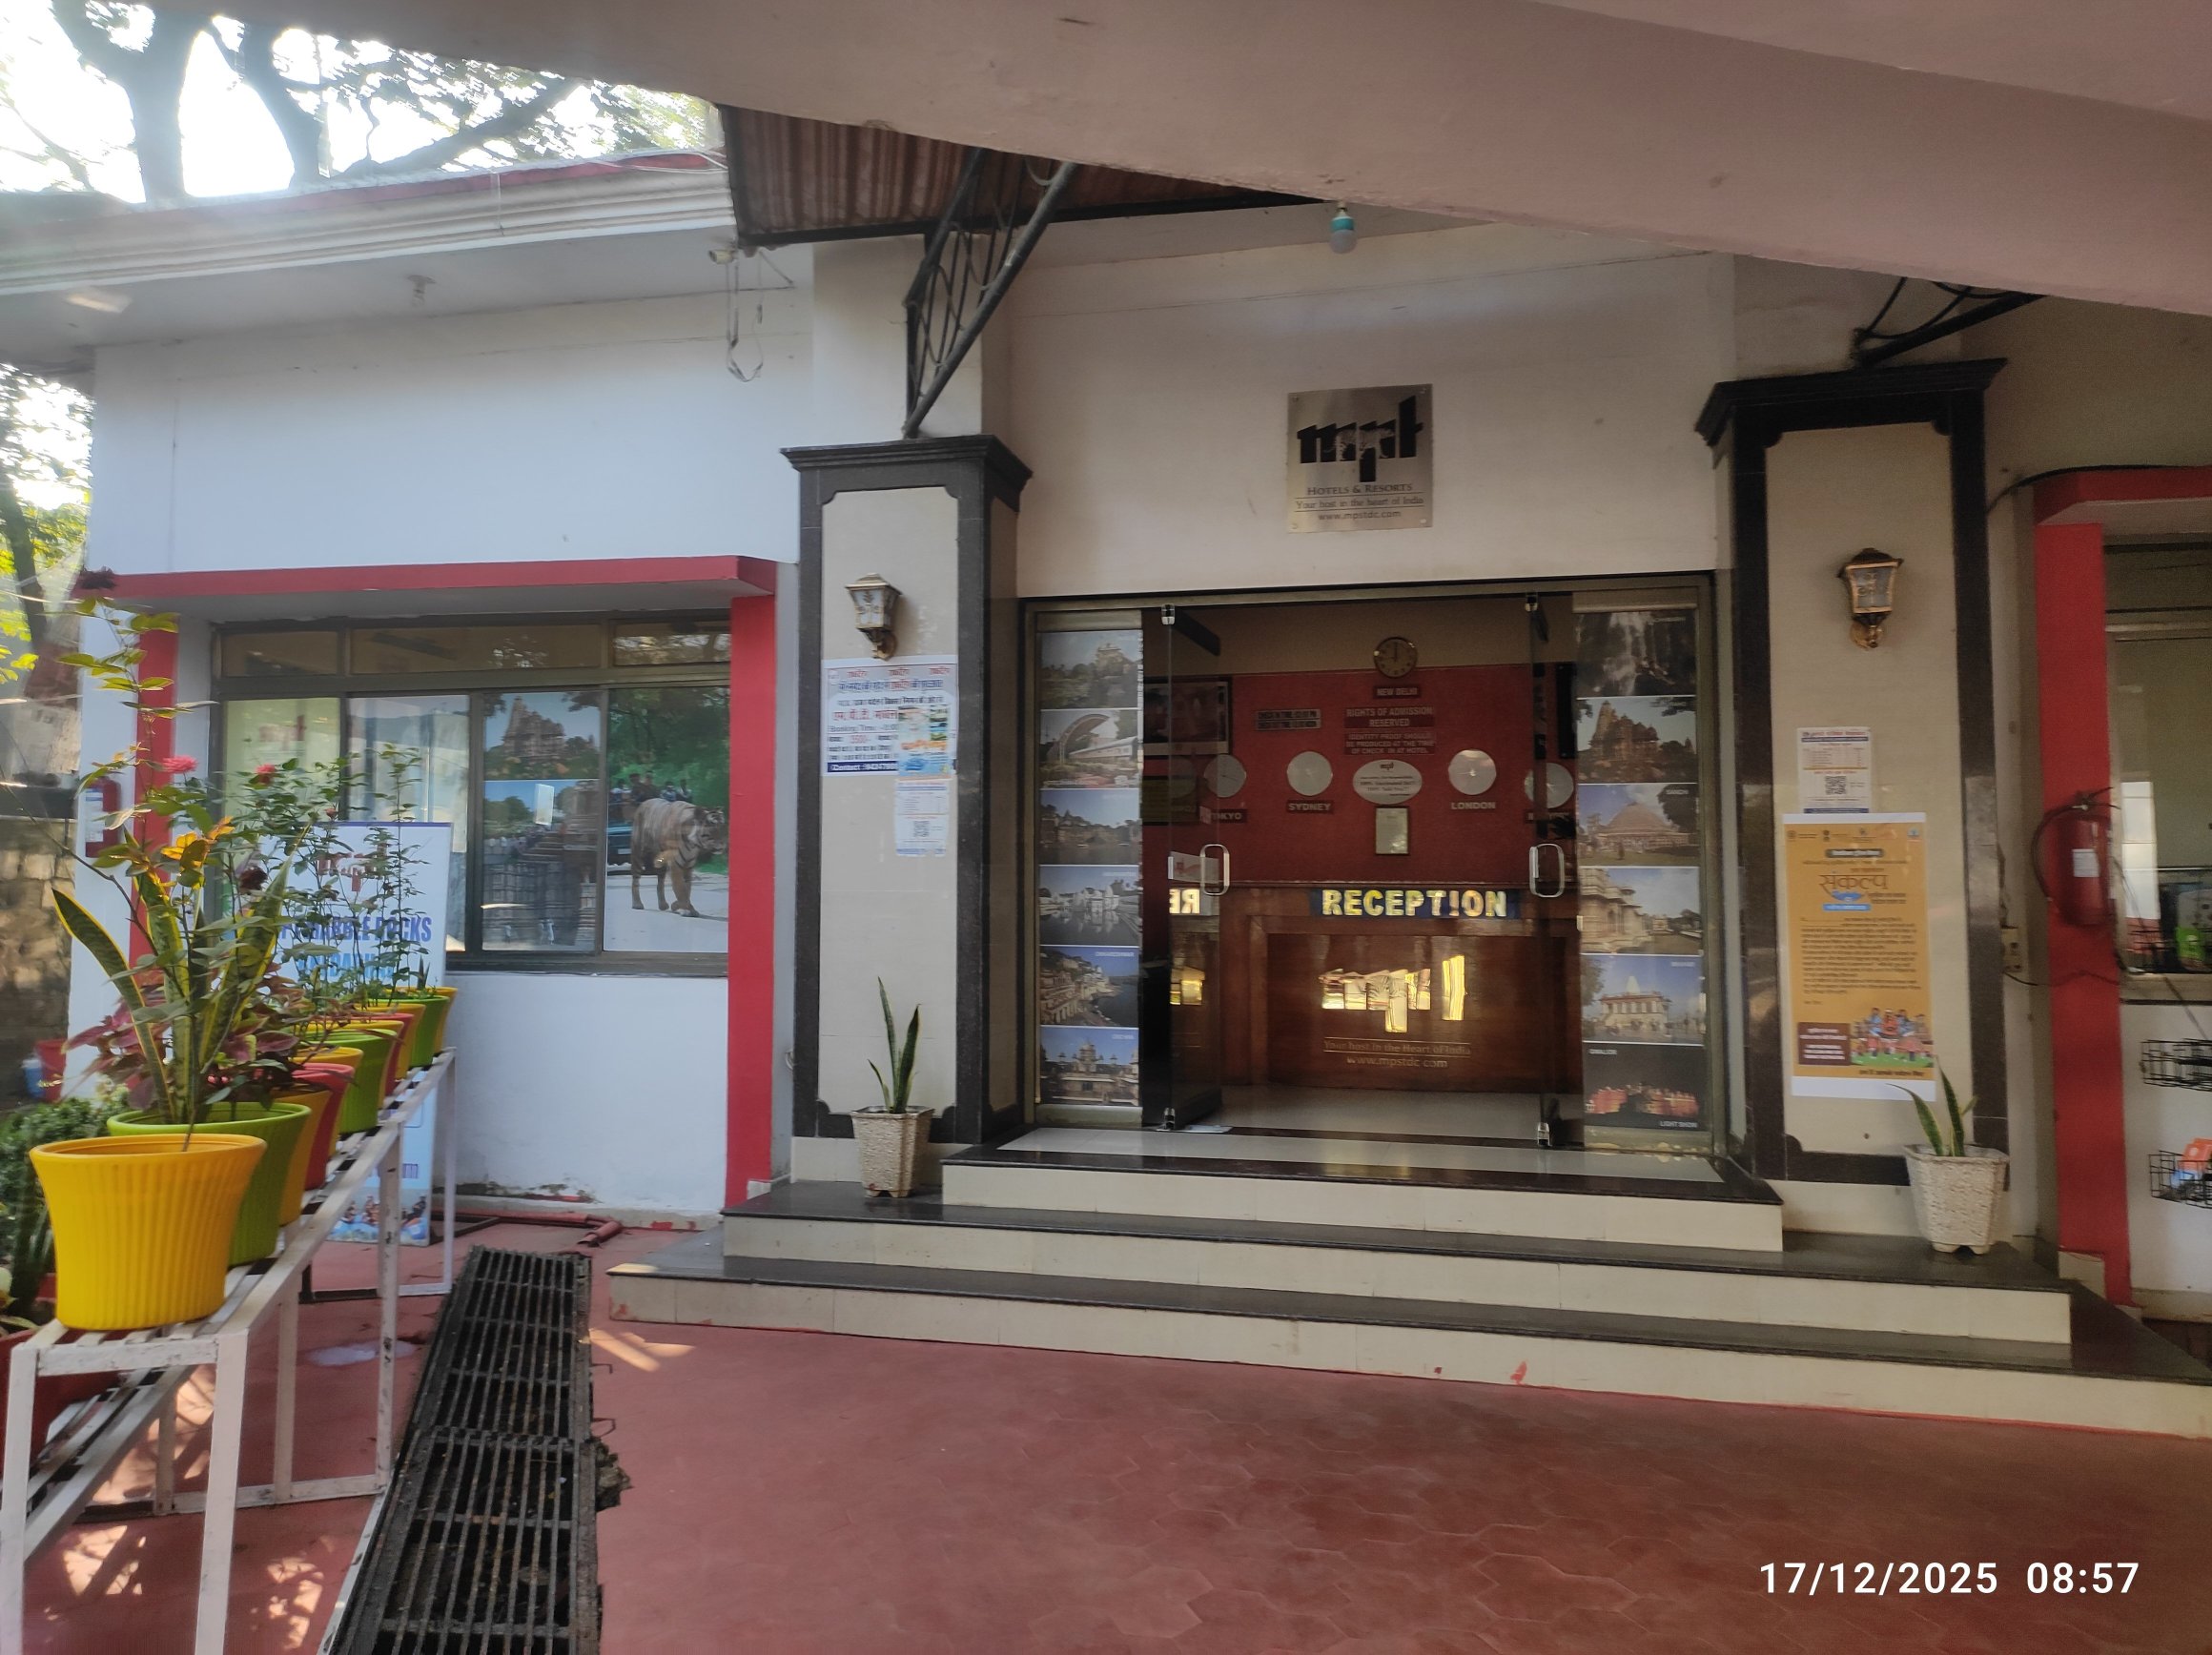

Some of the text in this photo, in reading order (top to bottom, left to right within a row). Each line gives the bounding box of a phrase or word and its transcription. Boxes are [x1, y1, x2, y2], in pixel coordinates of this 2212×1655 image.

[1307, 483, 1413, 496] HOTELS & RESORTS
[1295, 501, 1317, 509] Your
[1319, 500, 1337, 508] host
[1340, 499, 1347, 507] in
[1350, 498, 1363, 506] the
[1391, 497, 1401, 505] of
[1403, 496, 1424, 504] India
[1377, 687, 1394, 696] NEW
[1346, 706, 1433, 717] RIGHTS OF ADMISSION
[1369, 718, 1410, 726] RESERVED
[1288, 803, 1331, 811] SYDNEY
[1818, 870, 1889, 895] संकल्प
[1321, 889, 1507, 917] RECEPTION
[307, 916, 371, 941] MRBE
[1346, 1055, 1448, 1068] www.mpstdccom
